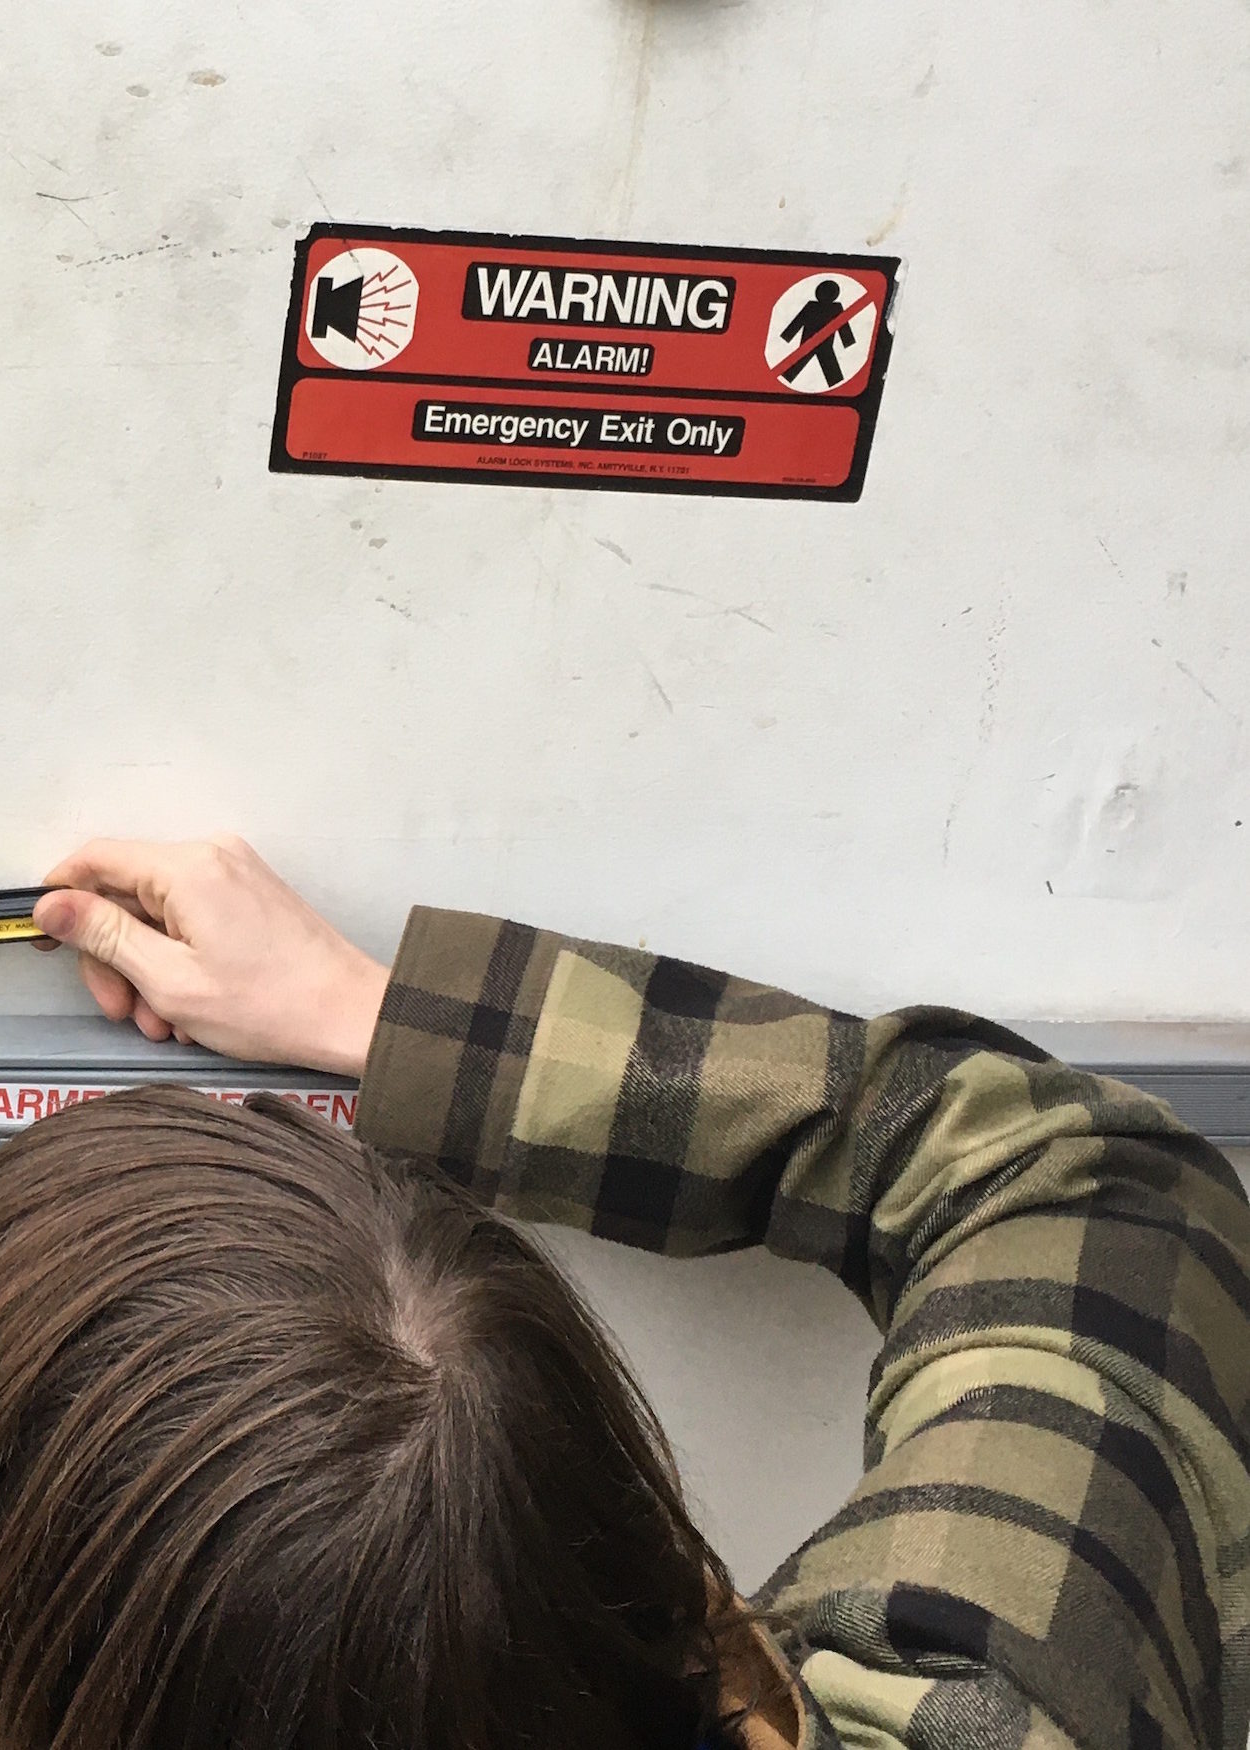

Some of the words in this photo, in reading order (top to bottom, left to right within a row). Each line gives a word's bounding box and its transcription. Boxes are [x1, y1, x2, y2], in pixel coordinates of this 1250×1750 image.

[476, 266, 729, 330] WARNING
[531, 342, 651, 374] ALARM!
[423, 404, 589, 447] Emergency
[599, 414, 655, 444] Exit
[665, 417, 734, 455] Only
[477, 456, 507, 465] ALARM
[509, 457, 532, 466] LOCK
